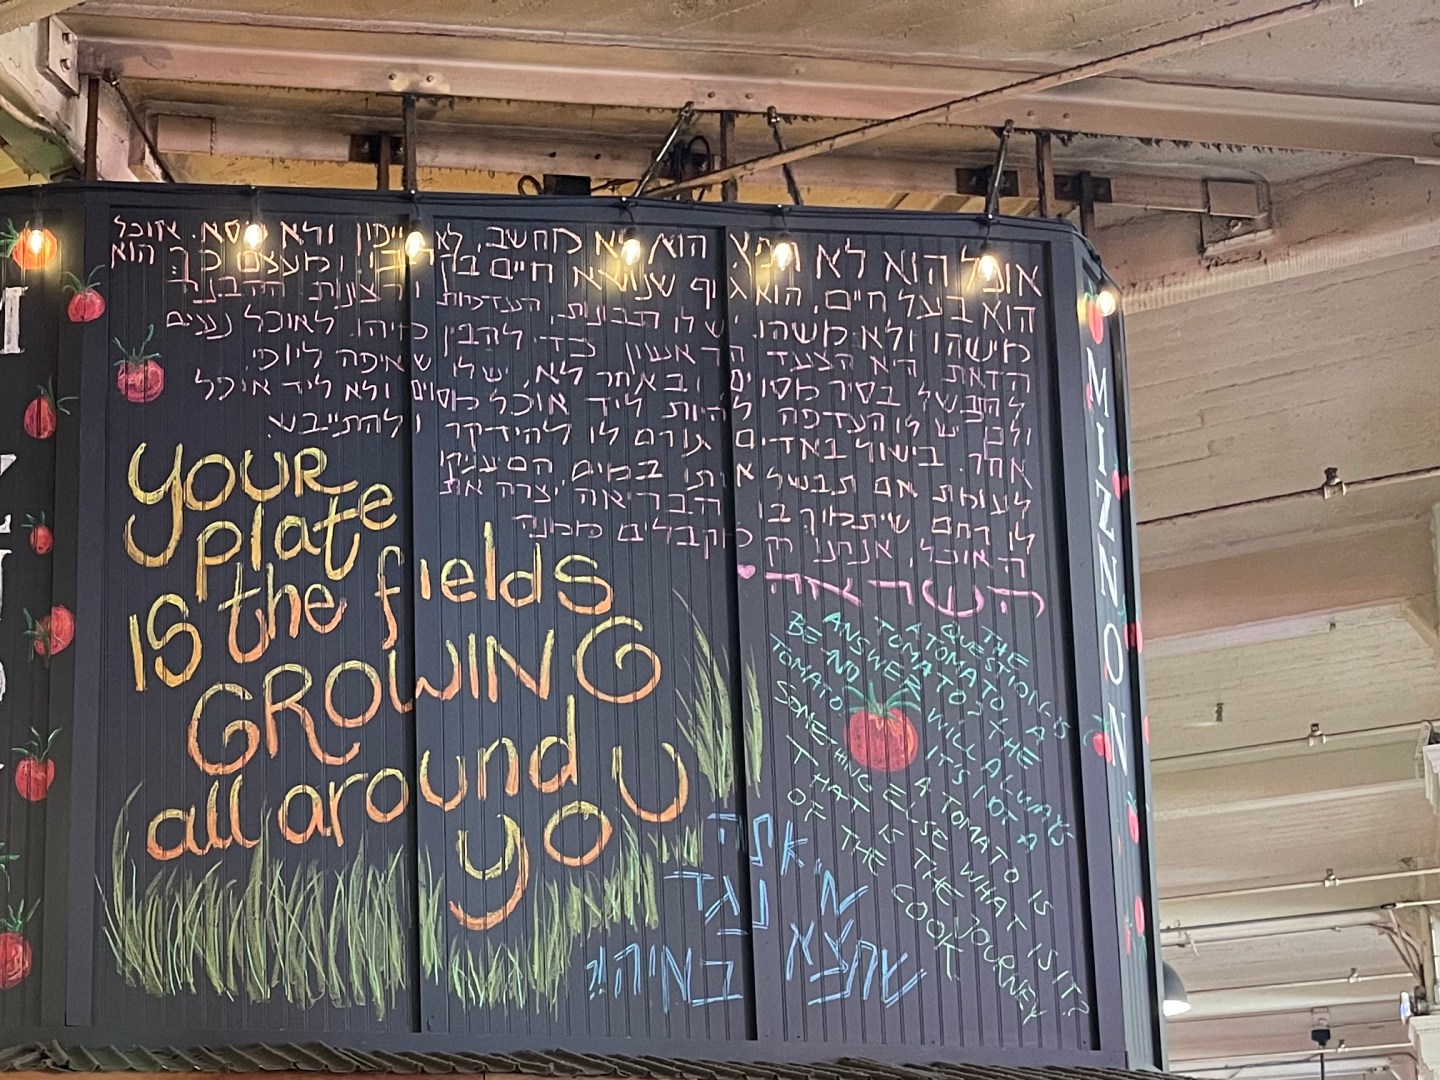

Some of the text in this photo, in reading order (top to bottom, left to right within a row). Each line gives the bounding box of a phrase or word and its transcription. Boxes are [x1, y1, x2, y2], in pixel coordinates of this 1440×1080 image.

[129, 521, 615, 693] IS the fields
[194, 483, 398, 604] plate
[1086, 346, 1130, 777] MIZNON
[186, 615, 662, 778] GROWING
[788, 610, 823, 645] BE
[905, 622, 923, 640] A
[980, 625, 1030, 668] THE
[146, 695, 581, 862] all around
[823, 611, 1075, 846] ANSWER WILL ALWAYS
[988, 719, 1040, 769] THE
[773, 681, 873, 793] SOMETHING
[883, 783, 949, 852] ELSE
[960, 862, 1028, 936] WHAT
[1028, 943, 1058, 971] IS
[786, 735, 870, 814] THAT
[914, 847, 965, 906] THE
[954, 913, 1047, 1025] JOURNEY
[787, 787, 963, 980] OF THE COOK
[942, 792, 1020, 883] TOMATO
[1028, 890, 1054, 916] IS
